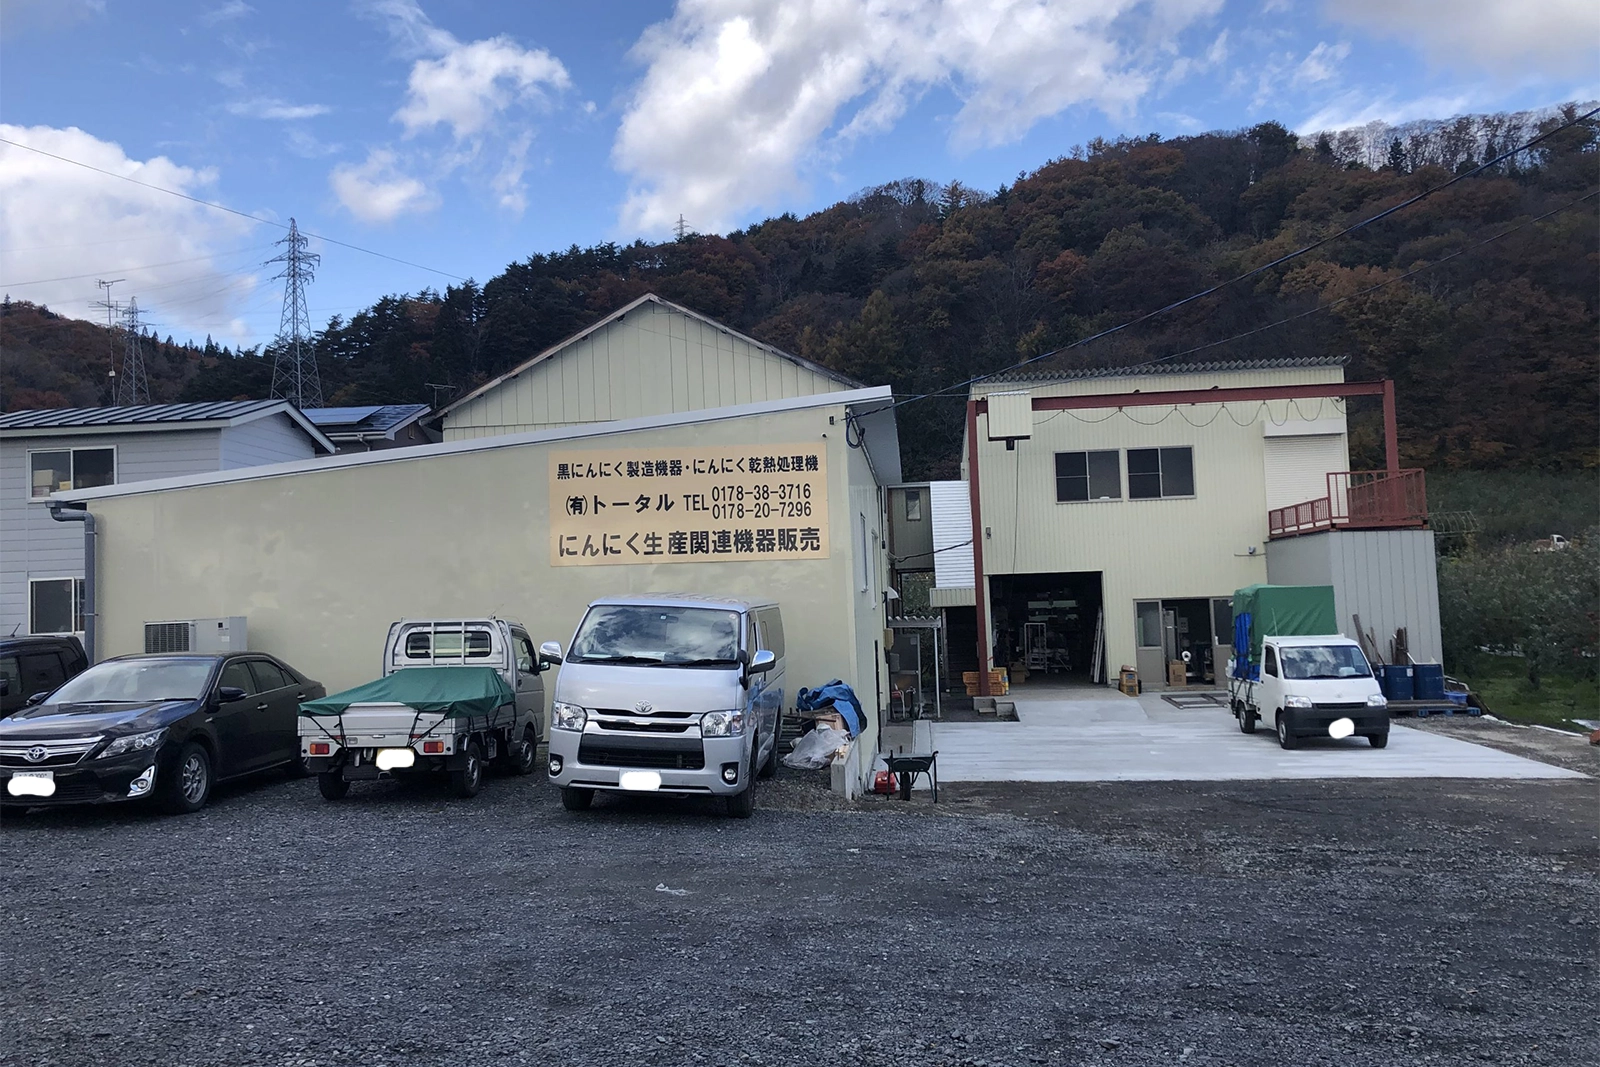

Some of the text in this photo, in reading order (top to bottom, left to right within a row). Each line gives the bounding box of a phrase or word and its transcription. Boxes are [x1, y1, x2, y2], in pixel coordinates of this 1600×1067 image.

[683, 494, 710, 512] TEL
[711, 483, 812, 501] 0178-38-3716
[711, 501, 812, 520] 0178-20-7296
[558, 527, 821, 558] にんにく生産関連機器販売
